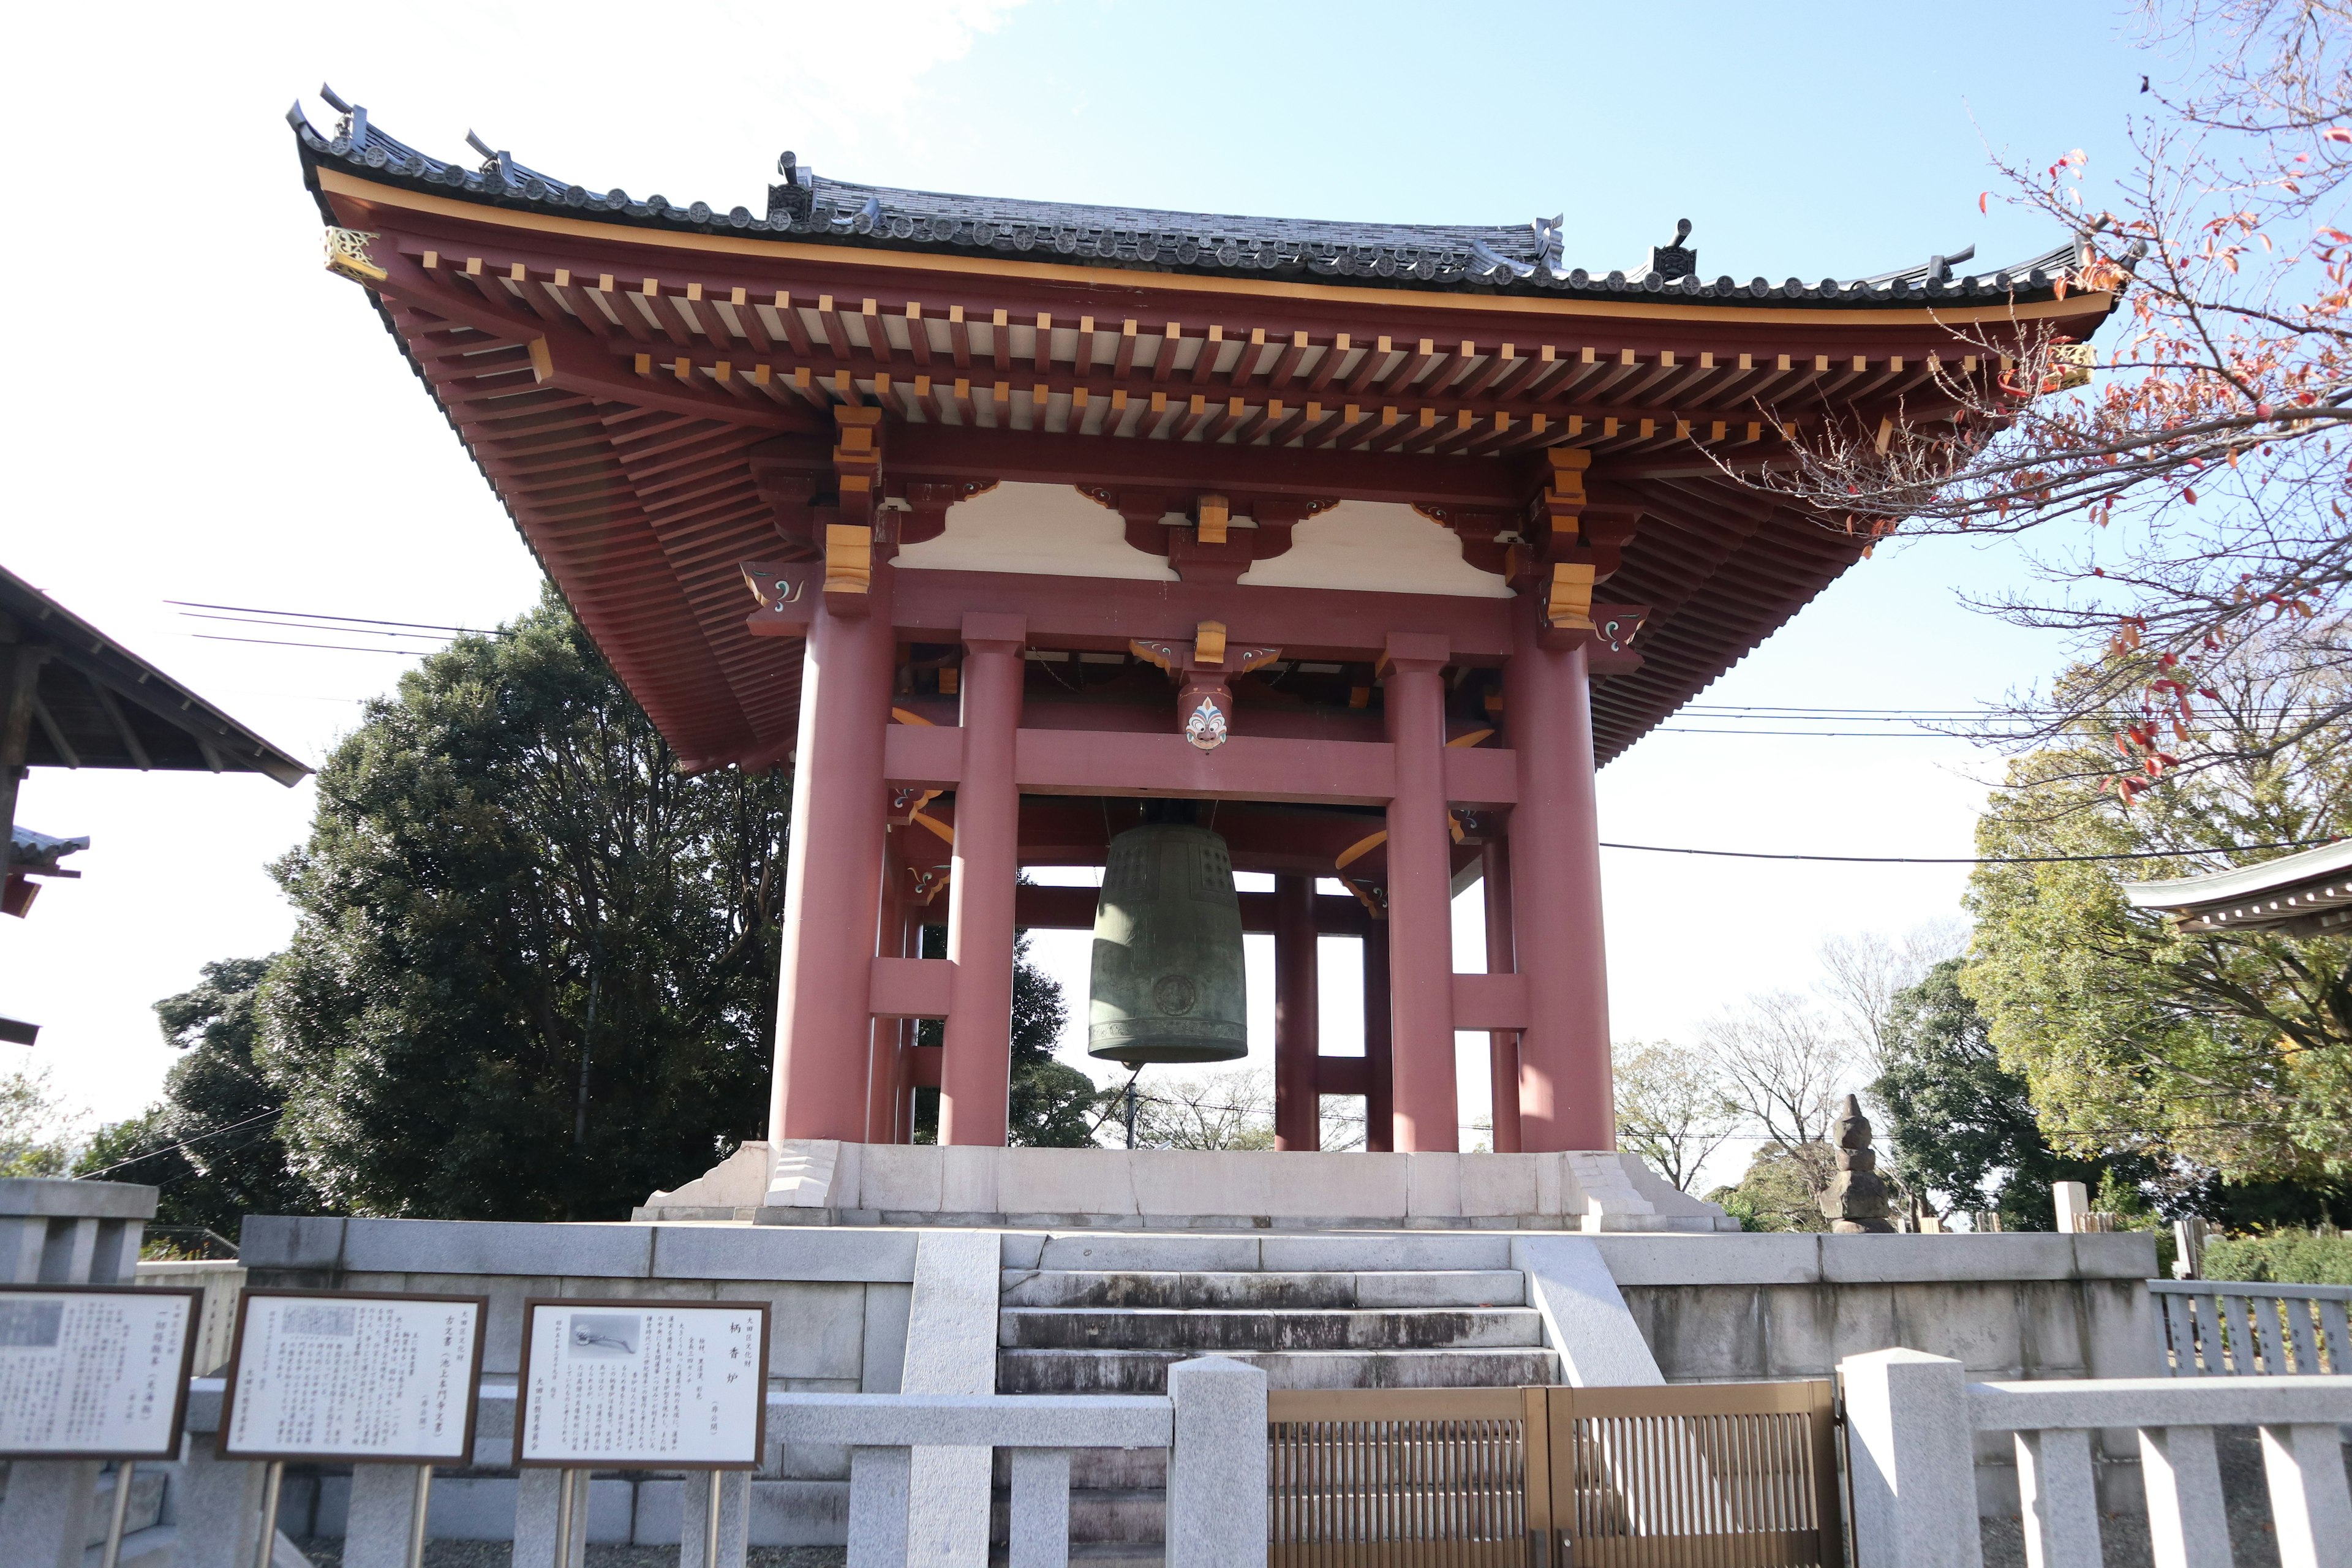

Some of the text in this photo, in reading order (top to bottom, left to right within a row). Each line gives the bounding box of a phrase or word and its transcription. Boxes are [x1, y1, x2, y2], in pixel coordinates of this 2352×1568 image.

[456, 1310, 469, 1362] 大田区文化財
[726, 1322, 742, 1384] 柄香炉
[744, 1316, 753, 1368] 大田区文化財
[530, 1377, 544, 1450] 大田区教育委員会
